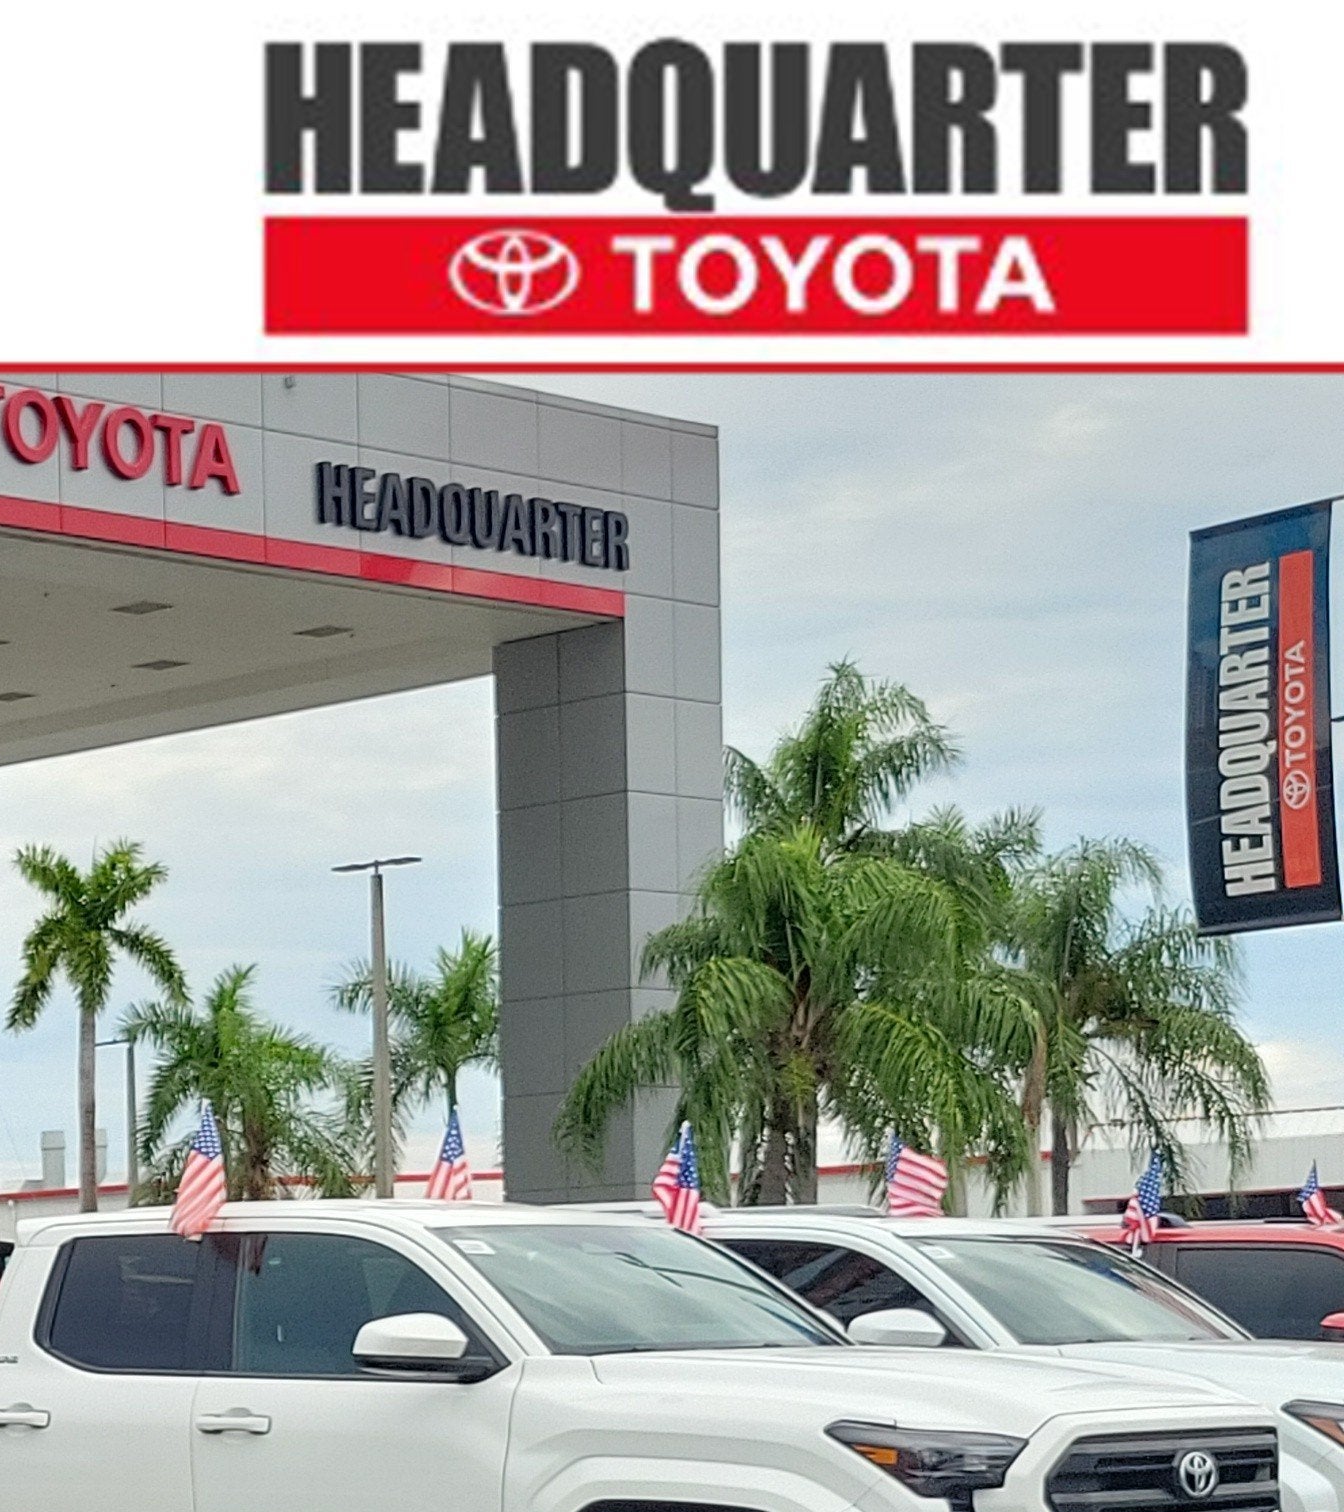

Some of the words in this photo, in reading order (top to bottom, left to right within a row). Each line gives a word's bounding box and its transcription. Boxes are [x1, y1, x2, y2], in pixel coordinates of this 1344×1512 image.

[316, 461, 629, 571] HEADQUARTER
[1217, 560, 1278, 898] HEADQUARTER
[1283, 640, 1307, 768] TOYOTA
